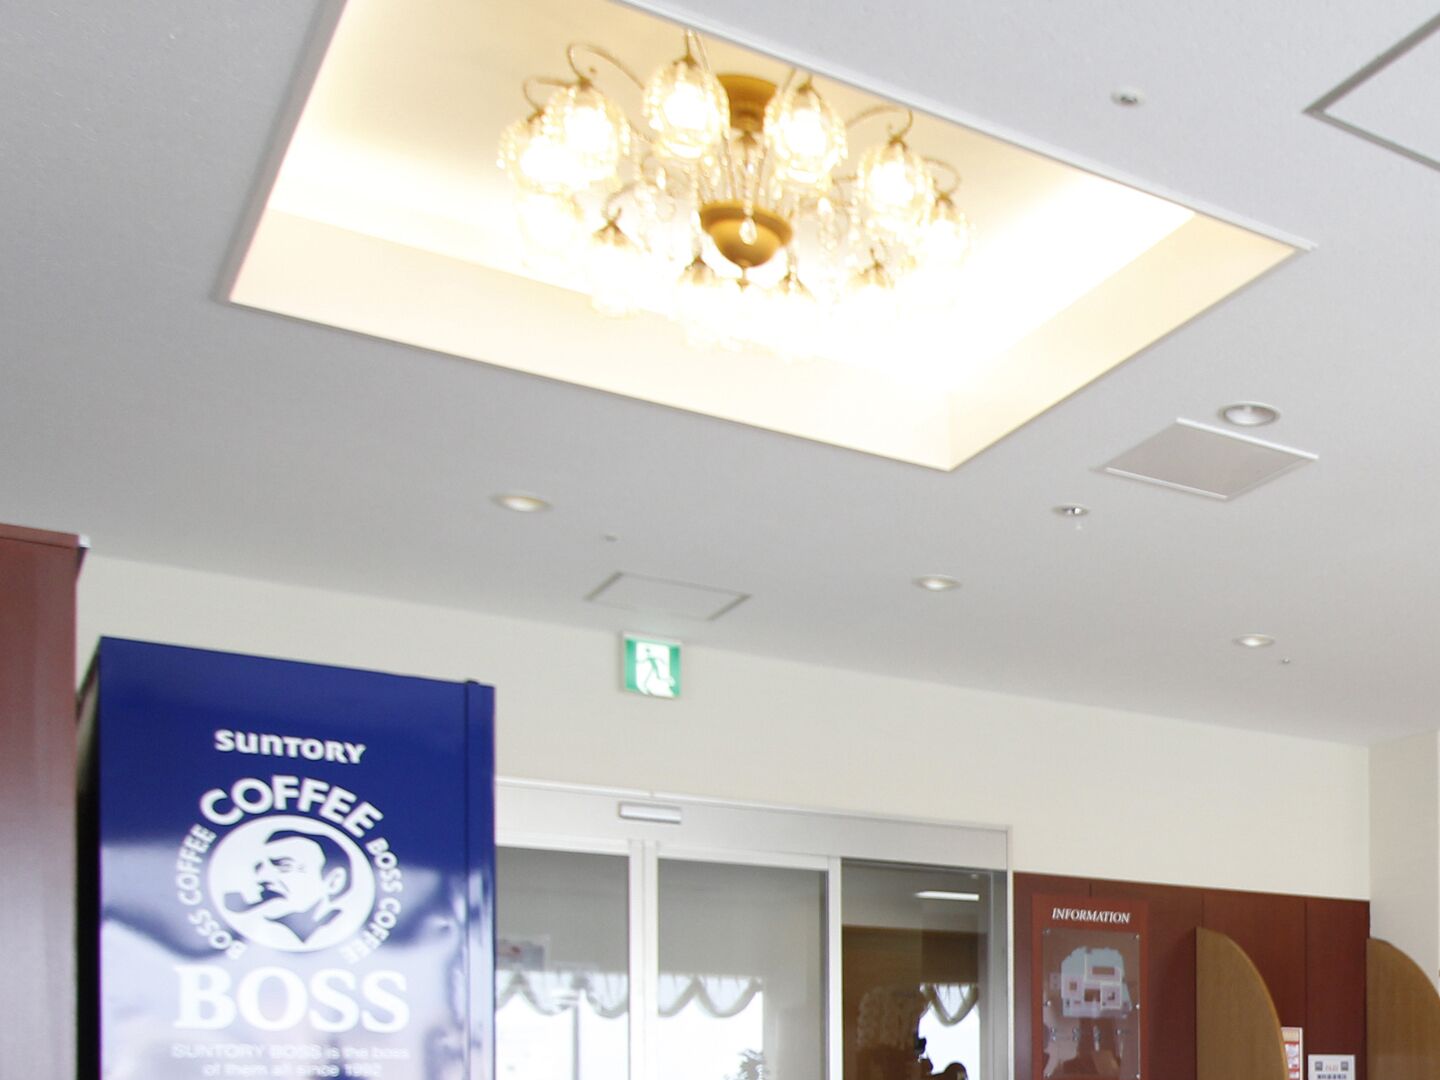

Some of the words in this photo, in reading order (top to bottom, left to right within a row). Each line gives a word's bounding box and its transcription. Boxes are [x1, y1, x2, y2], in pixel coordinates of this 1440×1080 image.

[200, 775, 384, 838] COFFEE
[176, 823, 218, 906] COFFEE
[365, 837, 403, 893] BOSS
[187, 909, 248, 960] BOSS
[339, 897, 402, 964] COFFEE
[1052, 907, 1130, 924] INFORMATION
[172, 964, 411, 1033] BOSS
[270, 1044, 322, 1059] BOSS
